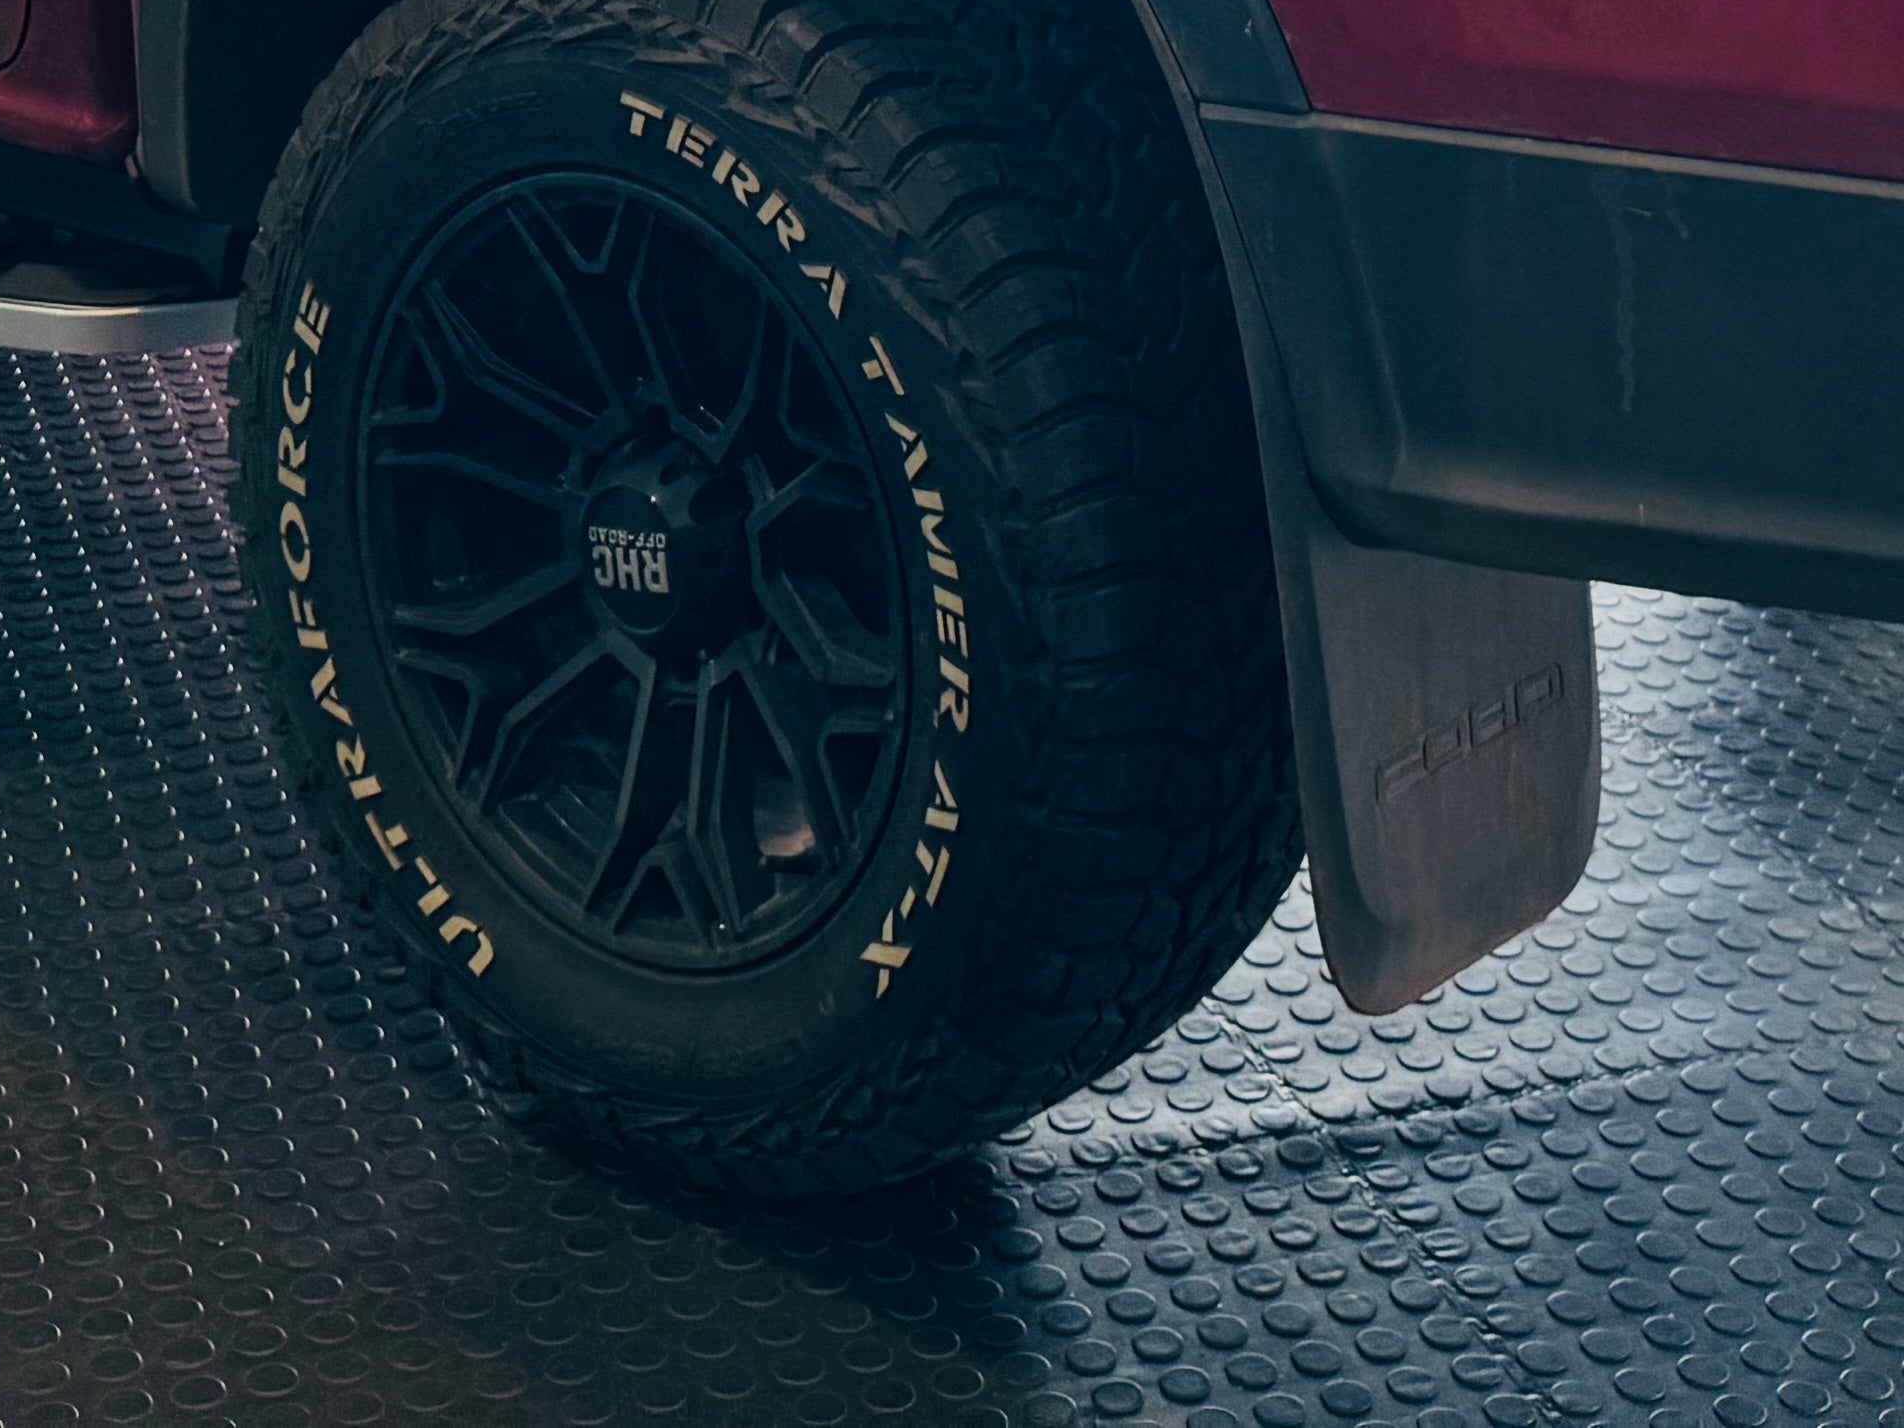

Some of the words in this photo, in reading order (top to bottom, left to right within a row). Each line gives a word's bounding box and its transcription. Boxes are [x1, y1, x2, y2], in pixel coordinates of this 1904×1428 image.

[619, 88, 846, 320] TERRA
[276, 280, 495, 978] ULTRAFORCE
[587, 525, 667, 549] OFF-ROAD
[591, 544, 671, 594] RHC
[860, 335, 971, 736] TAMER
[859, 758, 960, 1000] AT-X
